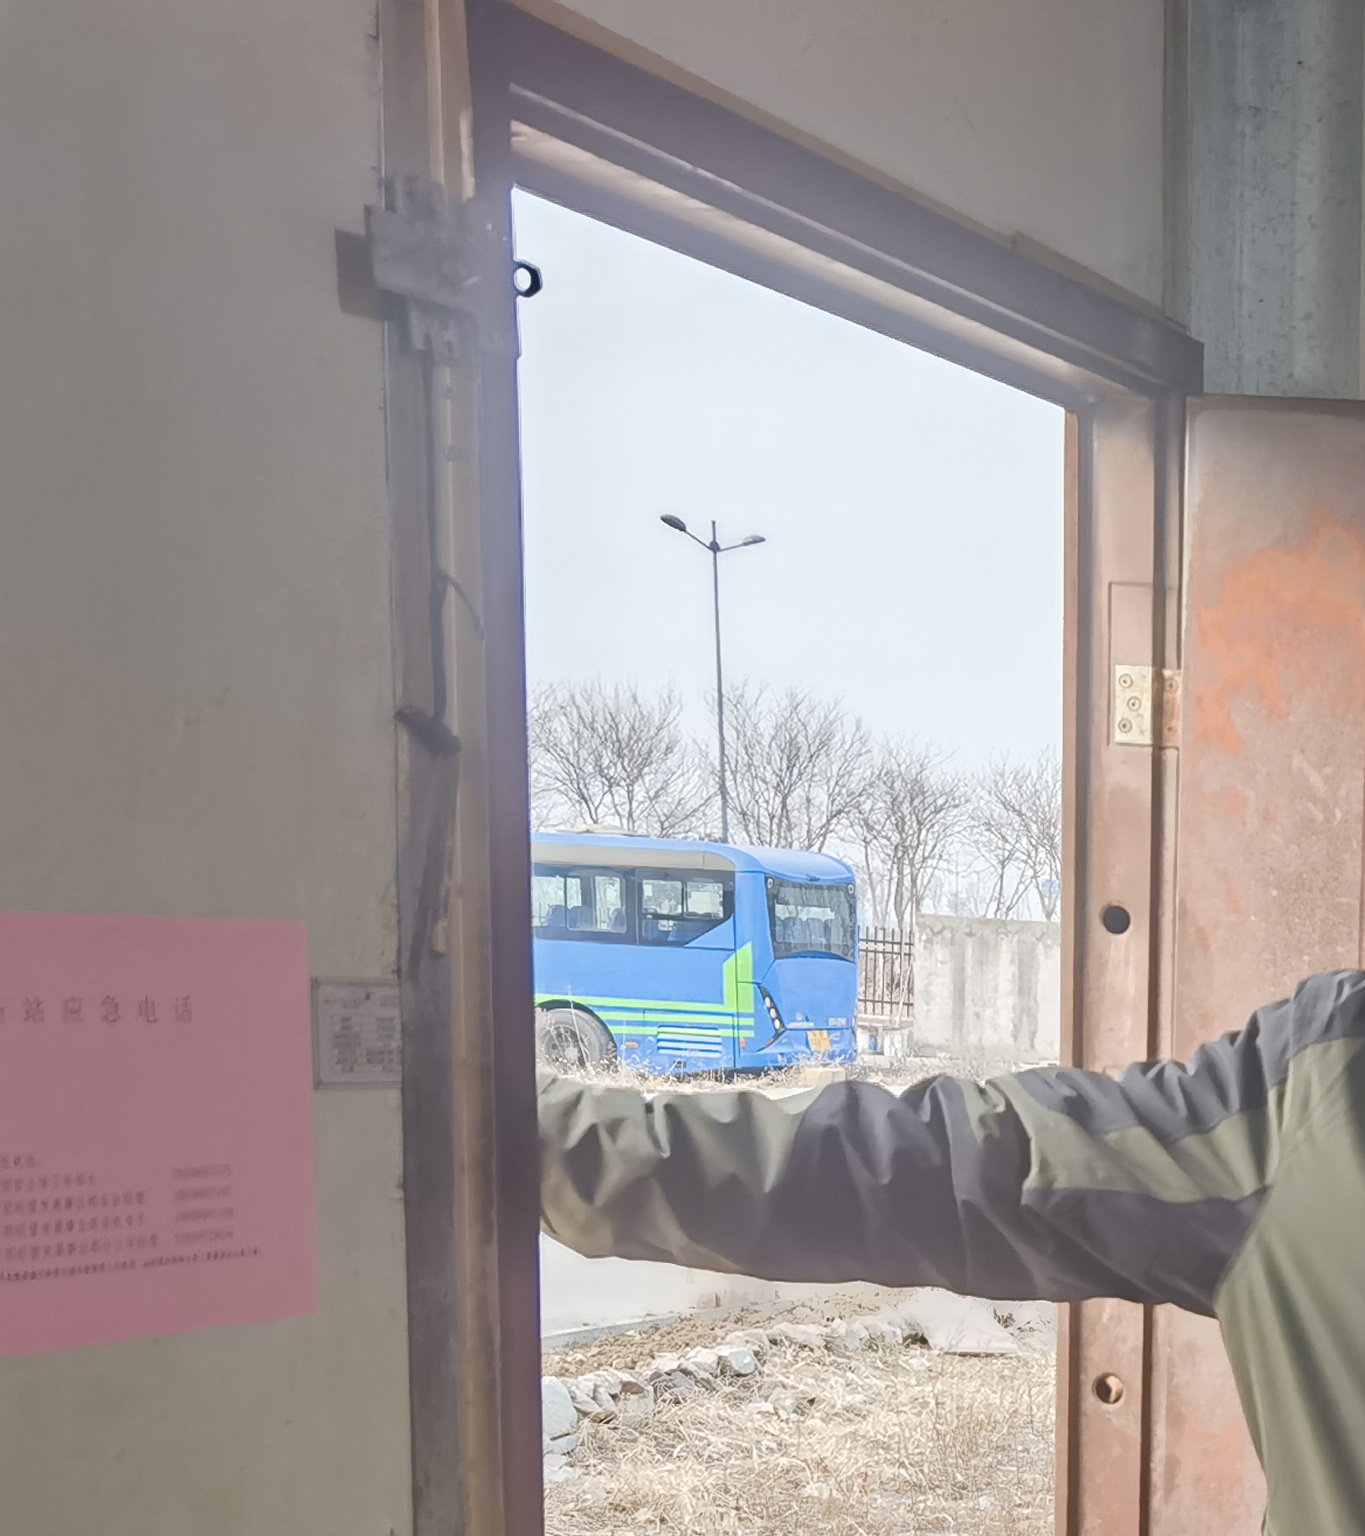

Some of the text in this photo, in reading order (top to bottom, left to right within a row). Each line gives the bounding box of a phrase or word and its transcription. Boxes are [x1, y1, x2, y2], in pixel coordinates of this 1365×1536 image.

[0, 994, 194, 1024] 站应急电话
